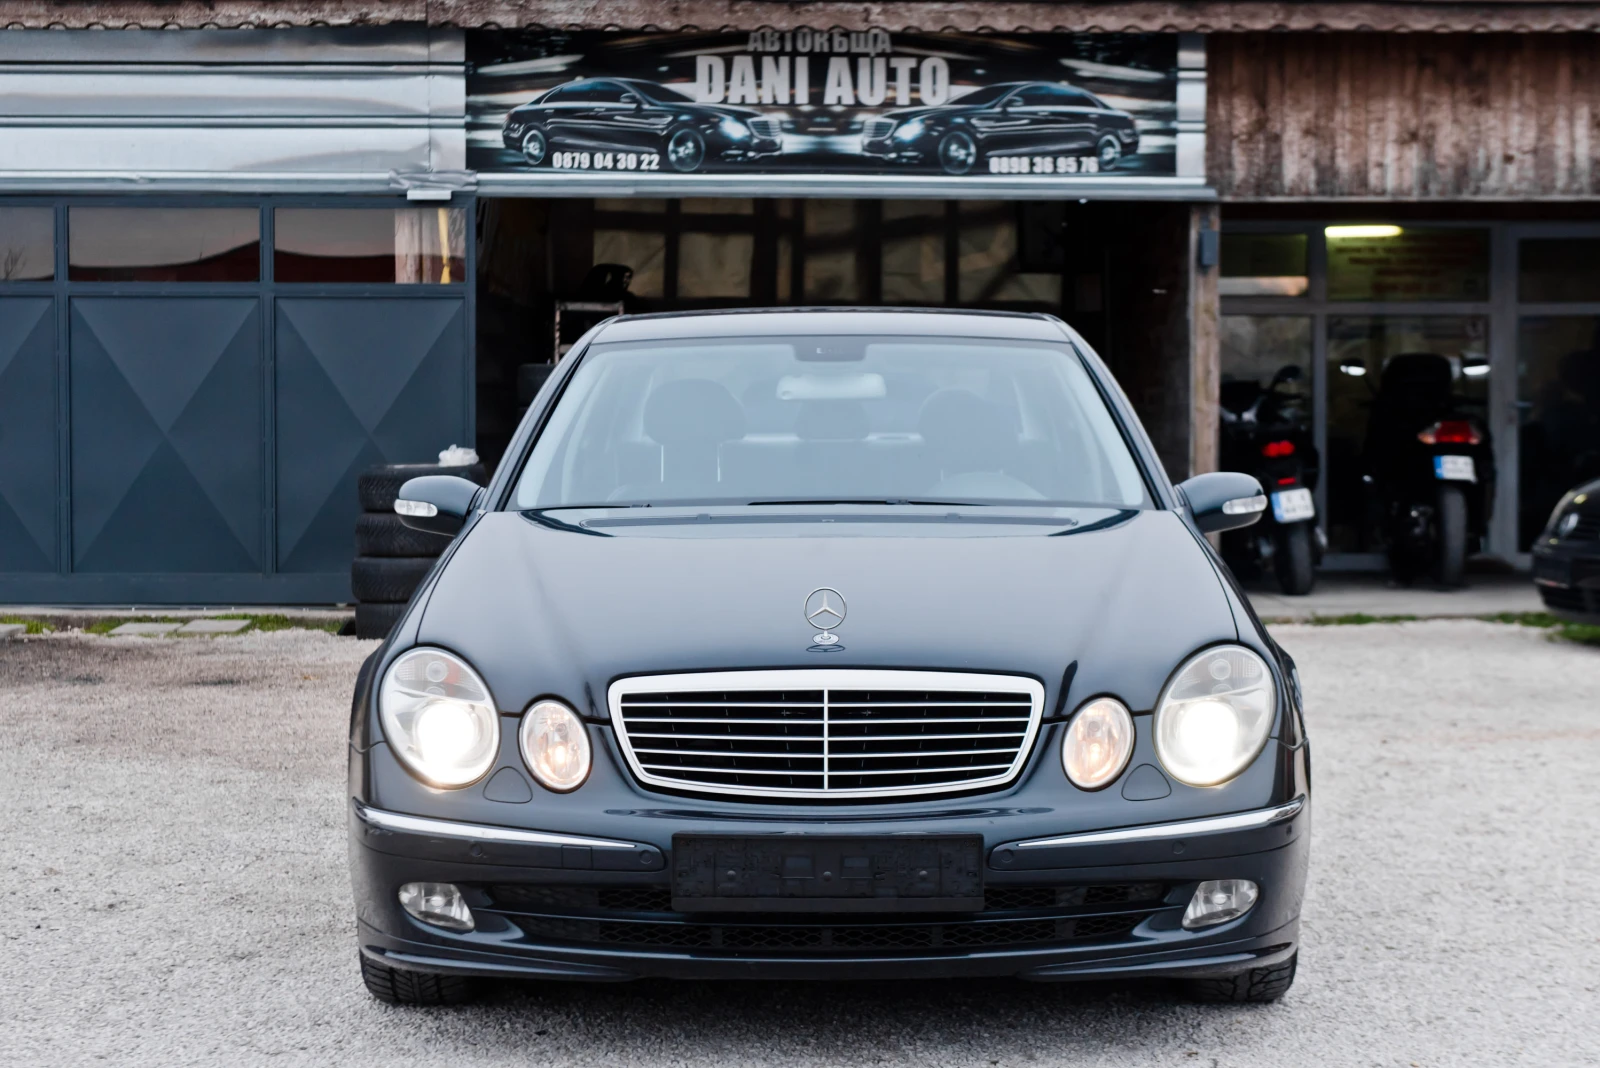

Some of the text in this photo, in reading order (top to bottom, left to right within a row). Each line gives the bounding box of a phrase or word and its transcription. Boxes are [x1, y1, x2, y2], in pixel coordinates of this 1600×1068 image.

[696, 55, 950, 106] DANI AUTO
[552, 151, 660, 170] 0879 04 30 22
[1032, 156, 1054, 174] 36
[1056, 156, 1078, 174] 95
